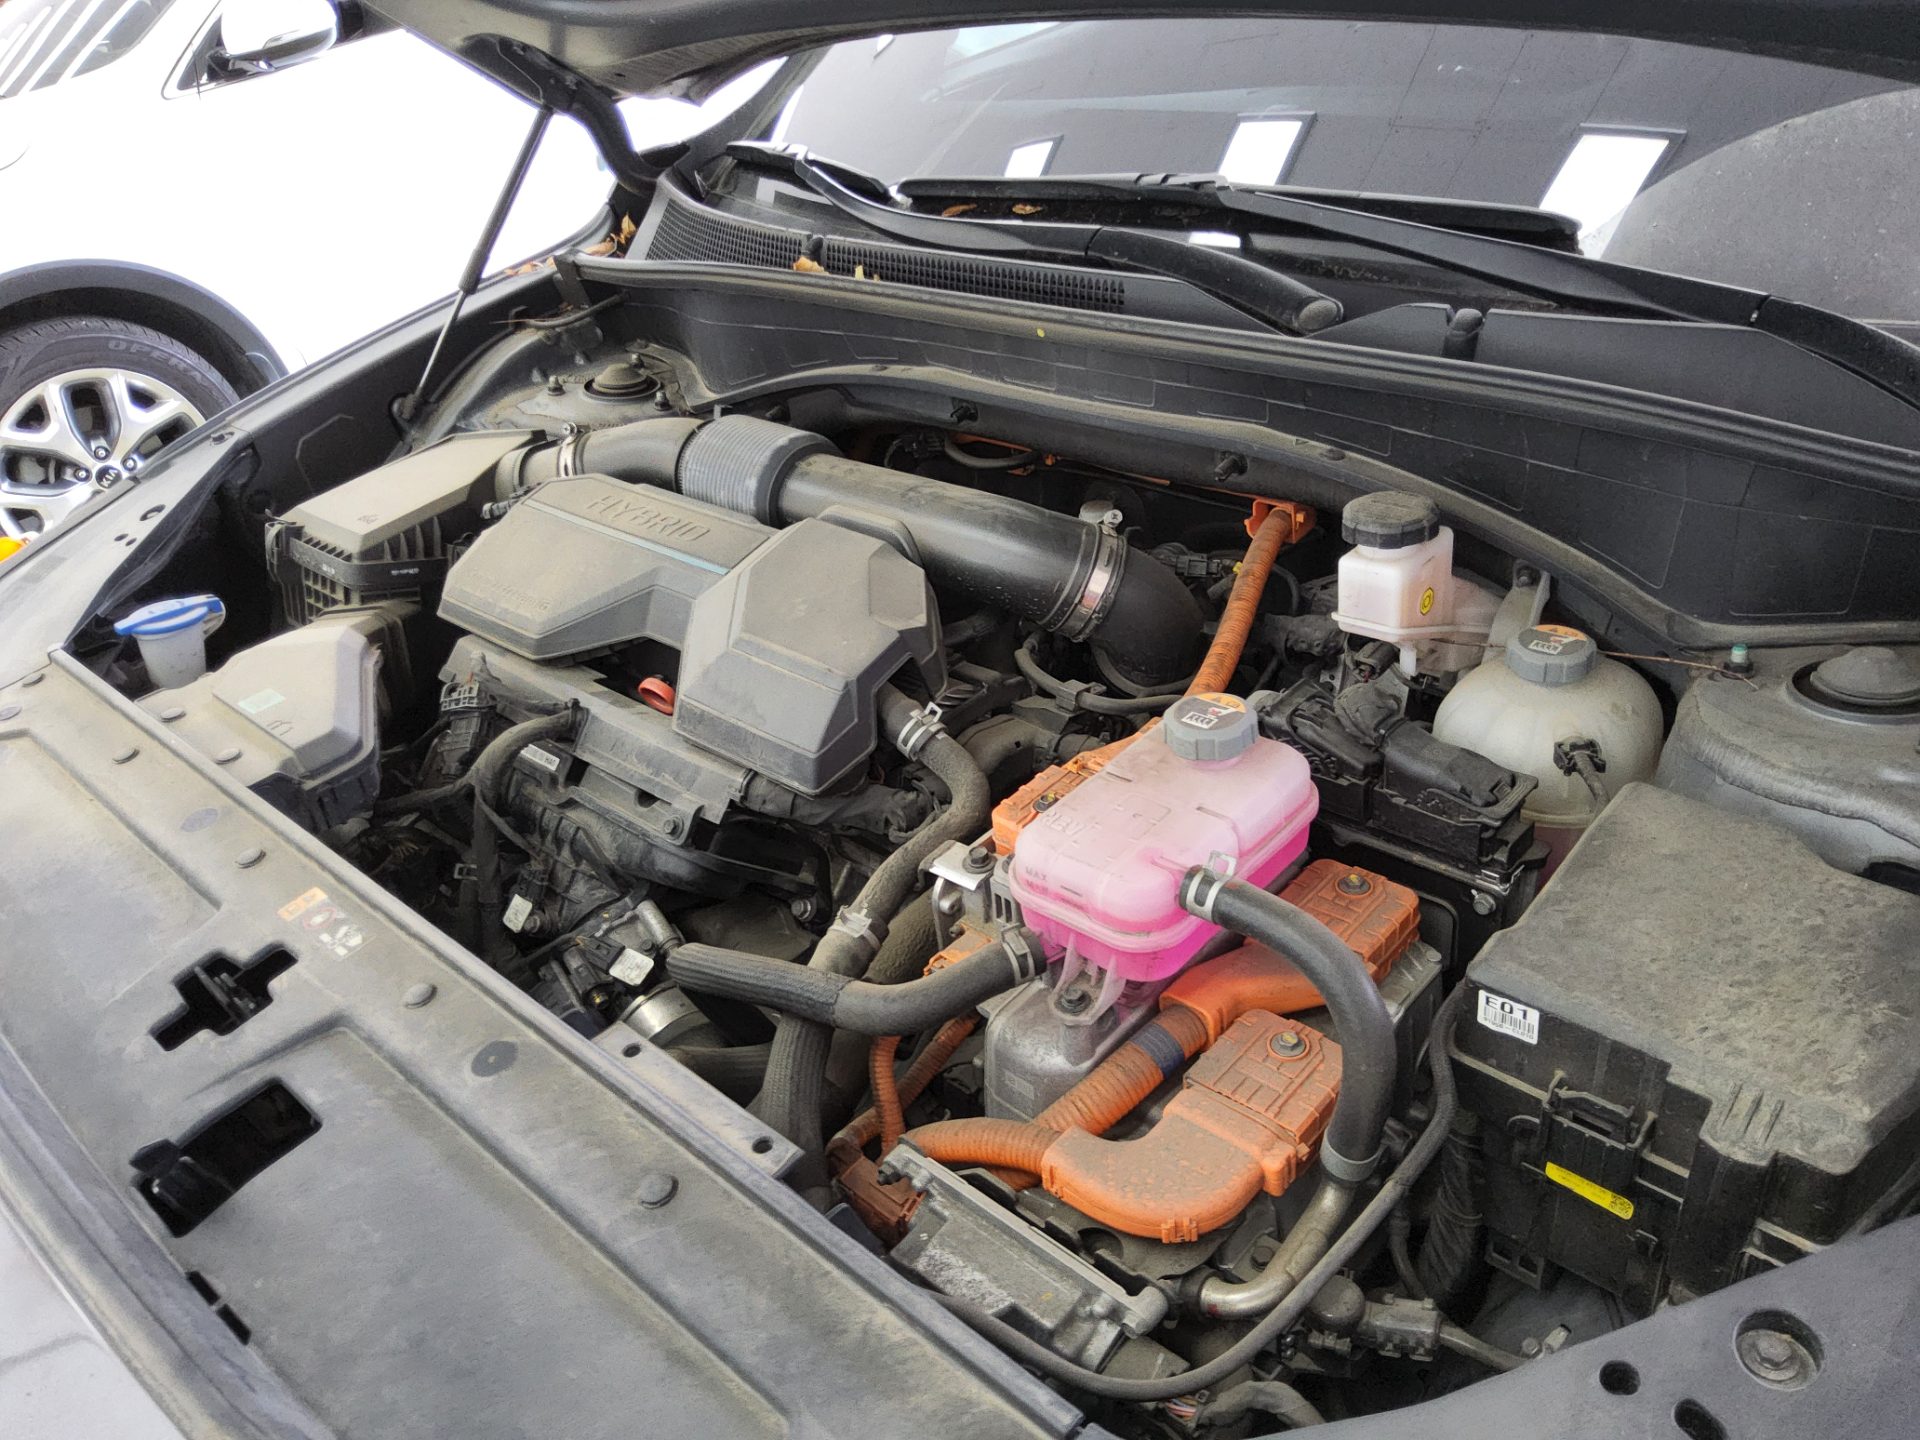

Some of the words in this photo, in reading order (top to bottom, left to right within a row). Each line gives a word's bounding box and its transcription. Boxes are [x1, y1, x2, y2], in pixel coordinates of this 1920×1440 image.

[100, 468, 118, 488] KIA
[586, 495, 711, 541] HYBRID
[1485, 995, 1527, 1021] E01
